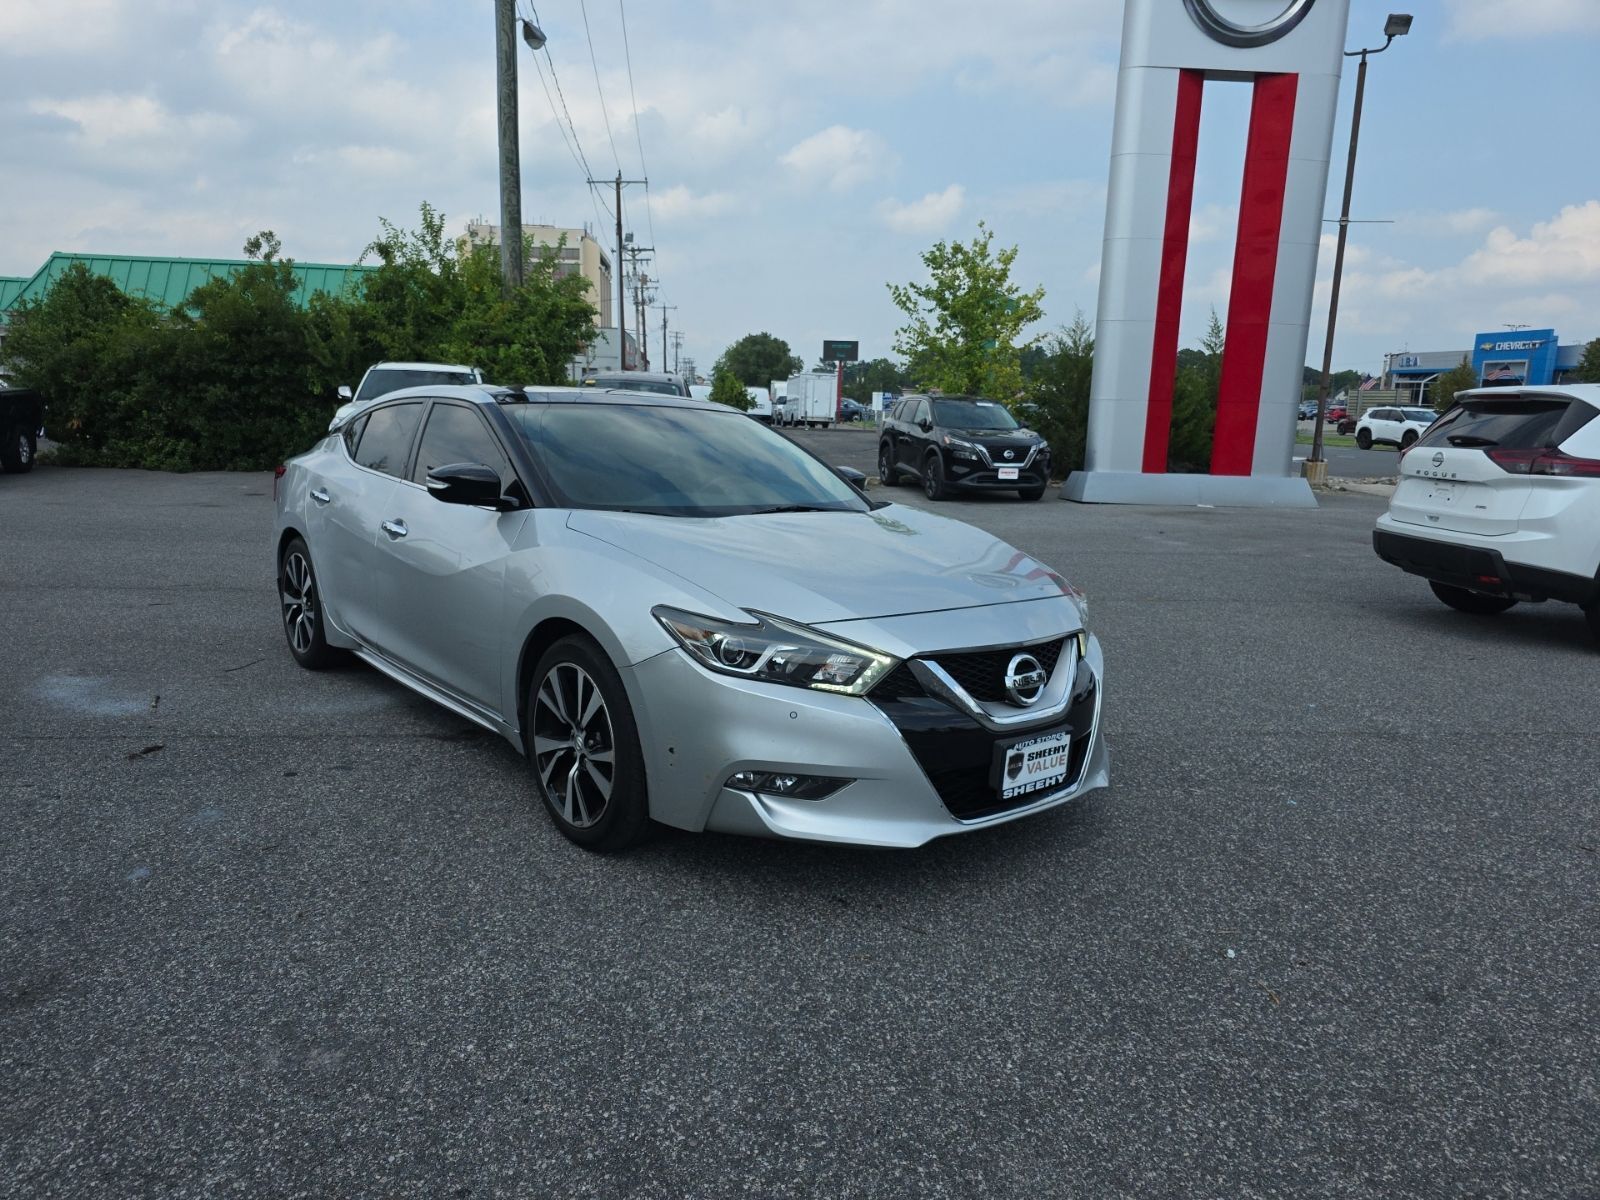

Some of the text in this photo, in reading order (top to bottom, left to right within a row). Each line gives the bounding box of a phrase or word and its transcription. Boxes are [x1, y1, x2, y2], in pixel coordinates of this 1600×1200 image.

[1416, 470, 1457, 478] ROGUE
[1013, 671, 1046, 688] NISSAN
[1014, 731, 1066, 751] AUTO STORES
[1027, 744, 1068, 761] SHEEHY
[1027, 754, 1066, 774] VALUE
[1003, 773, 1067, 799] SHEEHY
